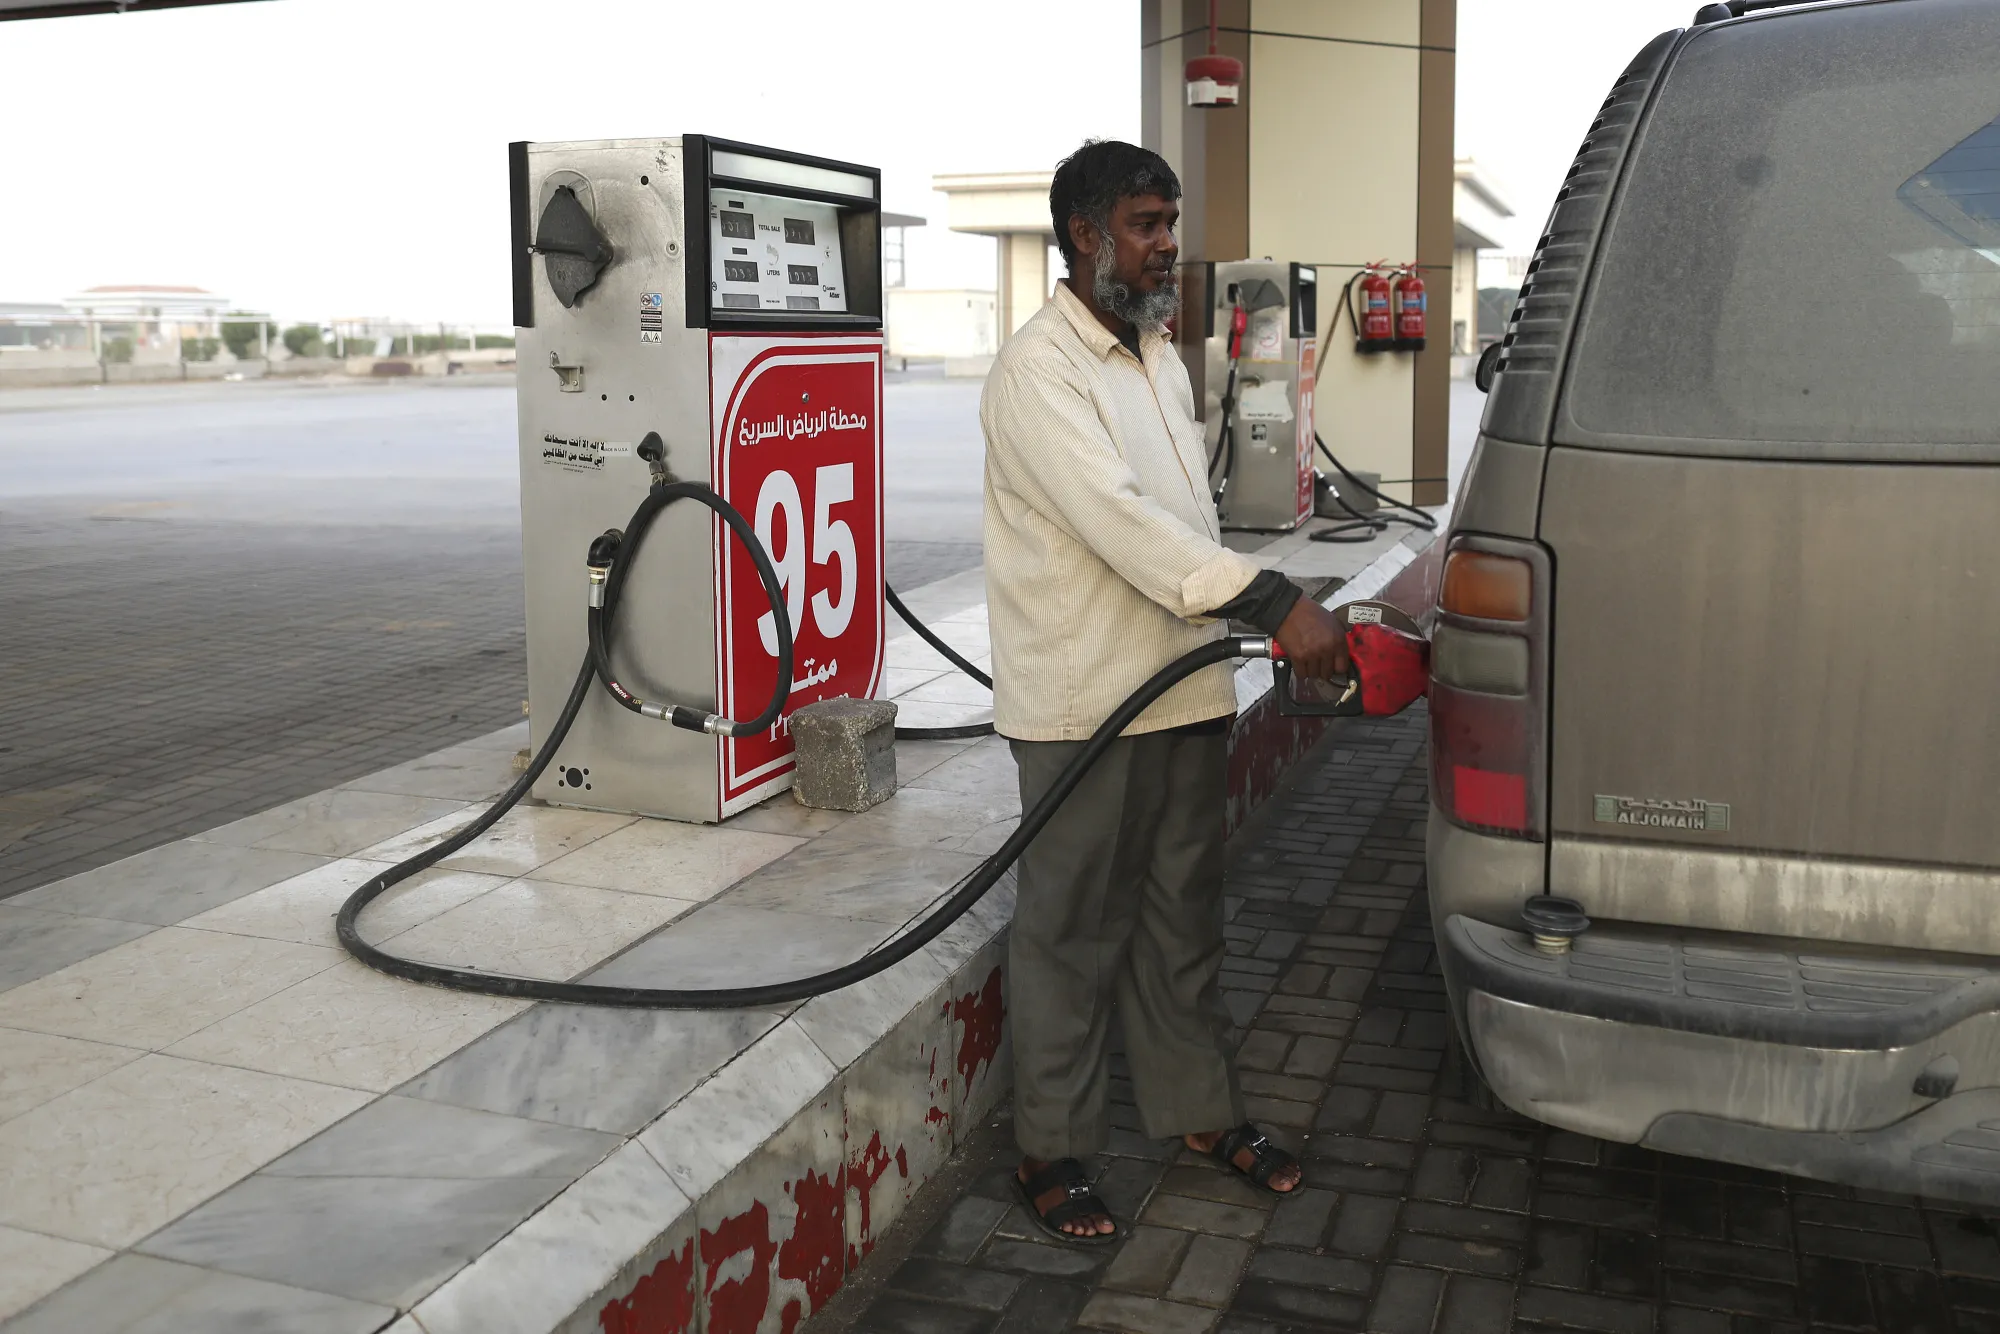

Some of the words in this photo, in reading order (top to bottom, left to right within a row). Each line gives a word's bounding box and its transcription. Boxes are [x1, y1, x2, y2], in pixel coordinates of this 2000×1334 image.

[758, 224, 770, 232] TOTAL
[739, 414, 784, 446] السريع
[786, 410, 827, 441] الرياض
[829, 406, 867, 431] محطة
[600, 441, 605, 451] لا
[754, 461, 858, 657] 95
[789, 657, 838, 693] ممت
[1617, 811, 1704, 830] ALJOMAIH
